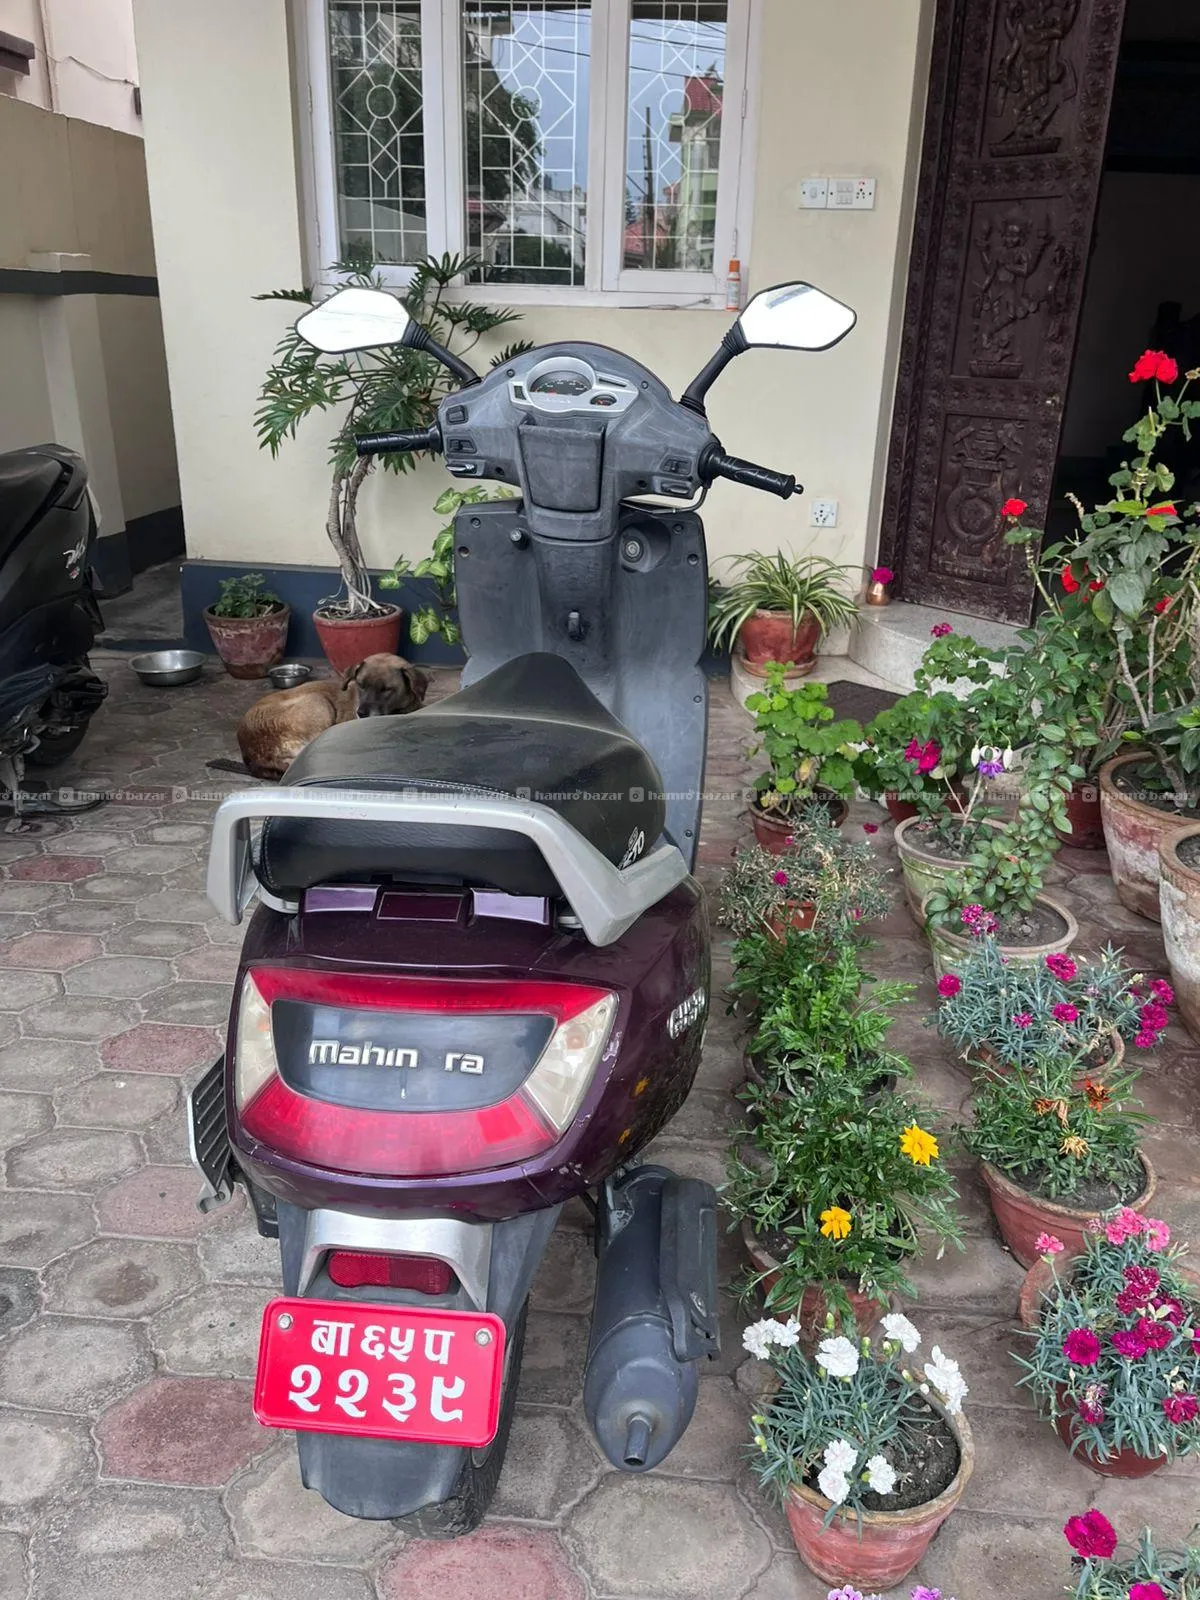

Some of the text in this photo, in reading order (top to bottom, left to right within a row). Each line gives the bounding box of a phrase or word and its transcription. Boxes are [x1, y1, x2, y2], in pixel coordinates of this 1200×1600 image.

[311, 1320, 456, 1365] बा ६५ प
